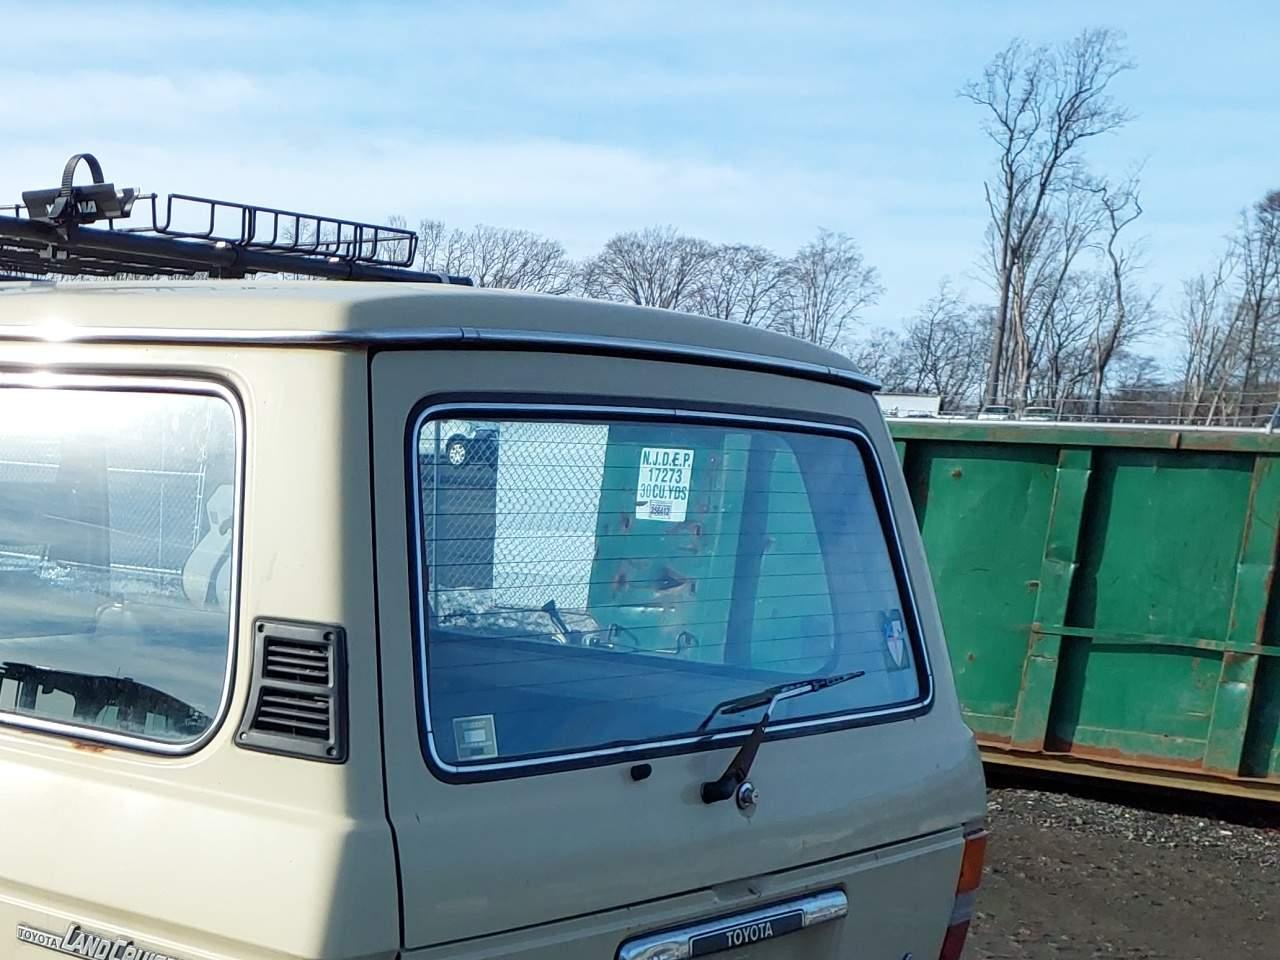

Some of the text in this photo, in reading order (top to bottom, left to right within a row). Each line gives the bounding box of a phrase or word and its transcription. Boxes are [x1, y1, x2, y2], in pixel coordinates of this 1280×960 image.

[642, 450, 691, 468] N.J.D.E.P.
[648, 467, 683, 484] 17273
[639, 483, 652, 498] 30
[18, 927, 60, 949] TOYOTA
[725, 921, 774, 948] TOYOTA
